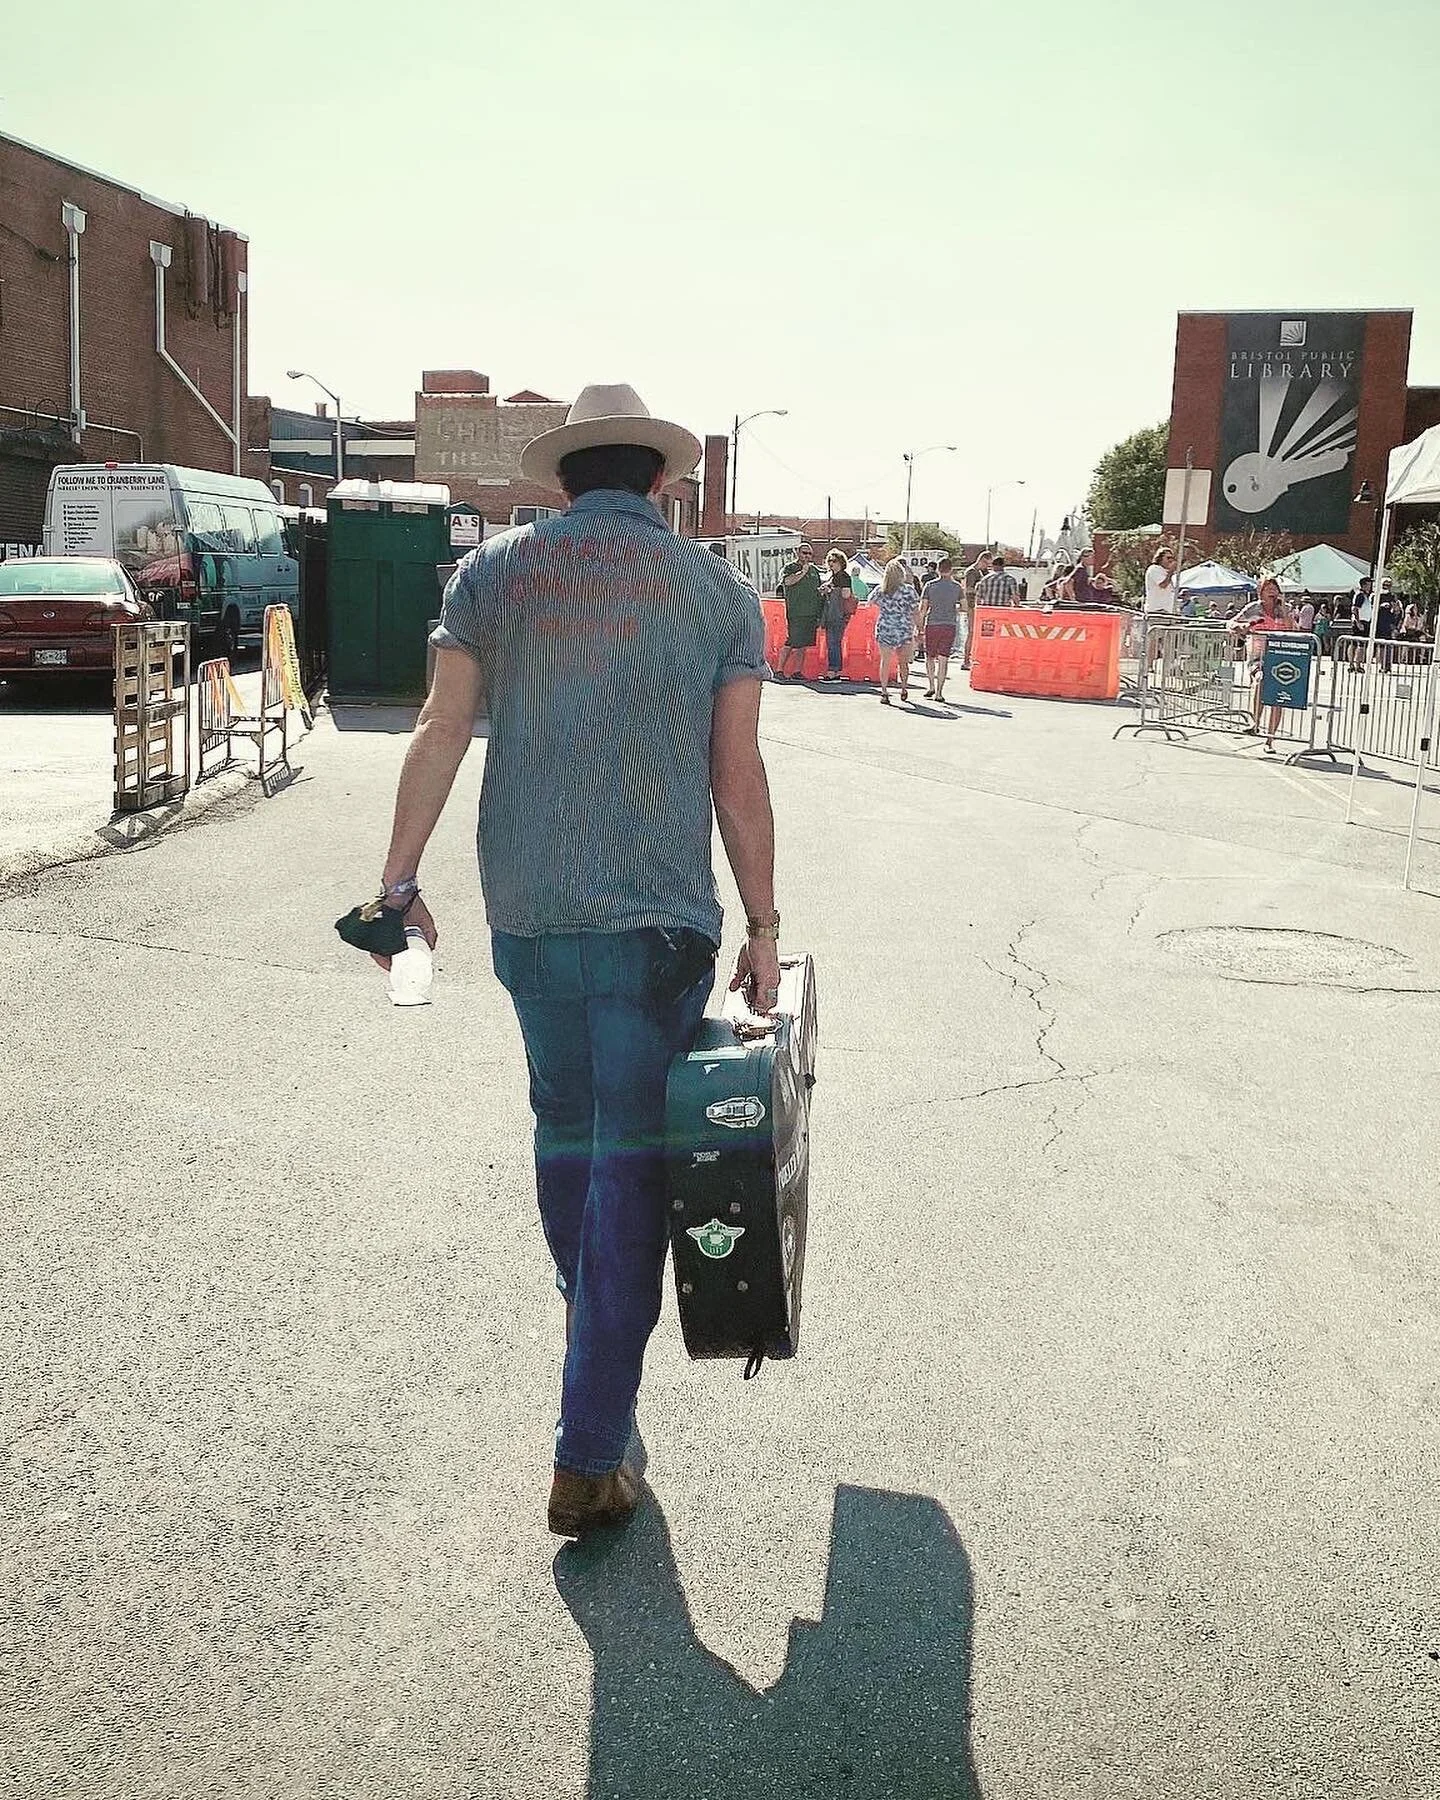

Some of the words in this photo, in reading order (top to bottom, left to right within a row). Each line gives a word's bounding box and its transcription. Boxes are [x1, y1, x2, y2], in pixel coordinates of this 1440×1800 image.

[1231, 351, 1290, 360] BRISTOL
[1300, 351, 1355, 360] PUBLIC
[1230, 363, 1353, 378] LIBRARY
[58, 476, 84, 484] FOLLOW
[86, 476, 96, 484] ME
[98, 476, 106, 484] TO
[107, 476, 147, 484] CRANBERRY
[148, 476, 165, 484] LANE
[452, 516, 462, 527] A
[471, 516, 478, 527] S
